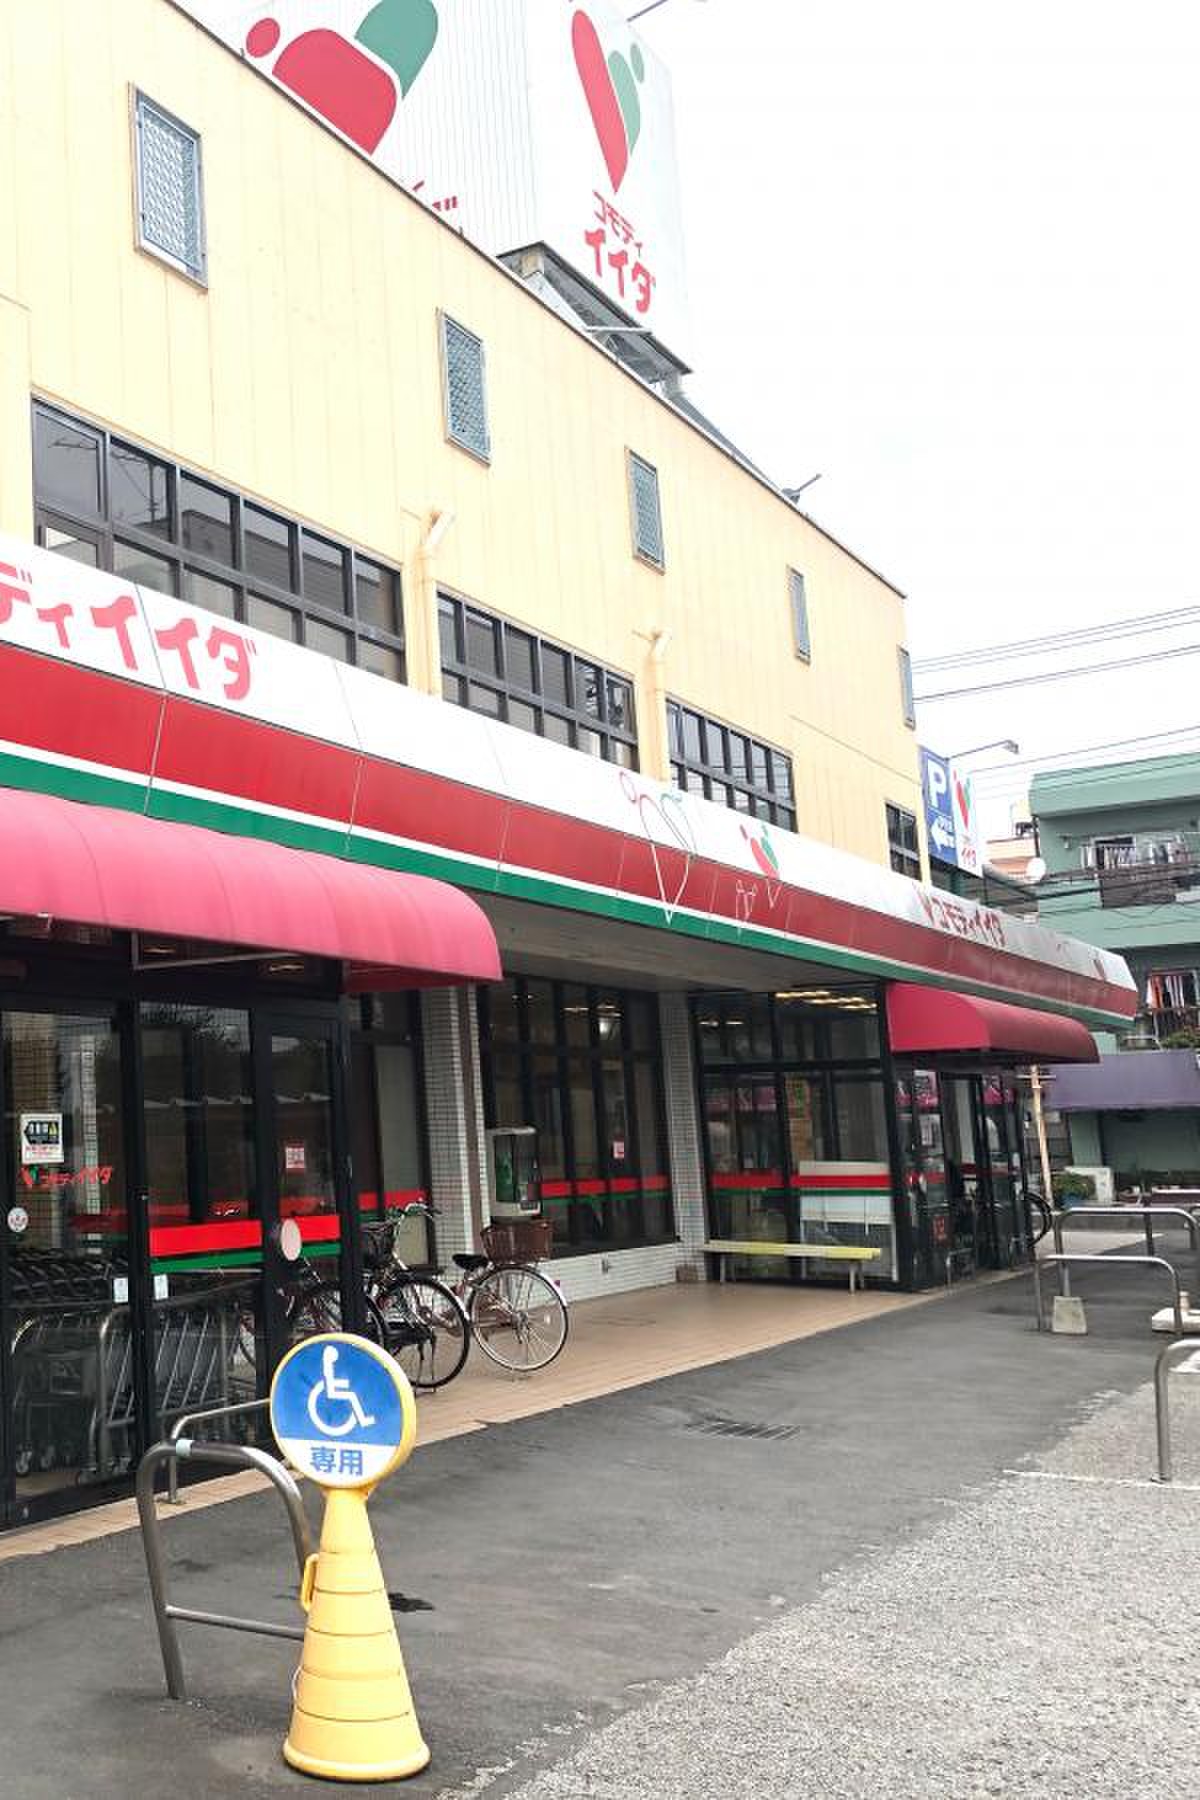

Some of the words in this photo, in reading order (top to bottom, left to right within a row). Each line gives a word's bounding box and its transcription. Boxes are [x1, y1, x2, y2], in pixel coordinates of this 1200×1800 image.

[584, 228, 656, 313] イイダ
[927, 758, 948, 809] P
[310, 1446, 363, 1476] 専用
